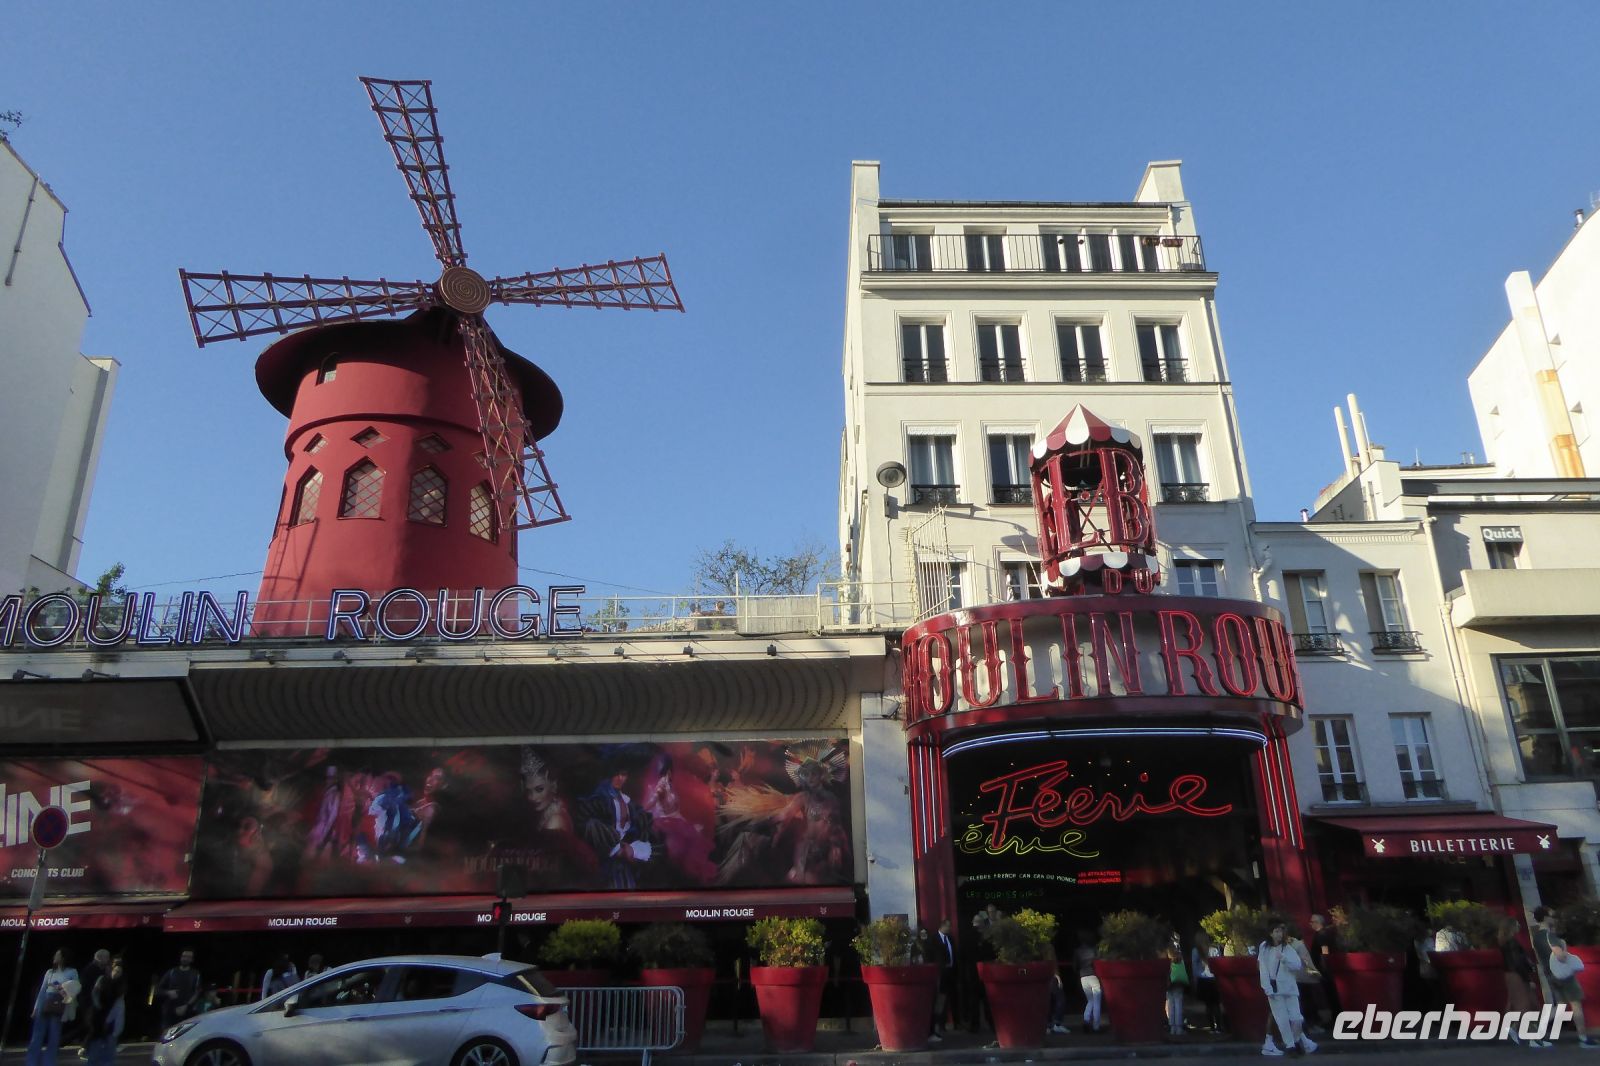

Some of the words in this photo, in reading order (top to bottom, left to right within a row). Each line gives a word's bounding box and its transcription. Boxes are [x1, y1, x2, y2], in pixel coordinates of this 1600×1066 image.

[1483, 528, 1521, 541] Quick
[1104, 568, 1154, 594] DU
[326, 584, 586, 642] ROUGE
[1409, 837, 1516, 853] BILLETTERIE
[60, 868, 85, 877] CLUB
[514, 912, 547, 922] ROUGE
[685, 909, 721, 918] MOULIN
[722, 908, 754, 917] ROUGE
[0, 918, 36, 927] MOULN
[37, 917, 70, 927] ROUGE
[267, 918, 304, 927] MOULIN
[305, 917, 338, 926] ROUGE
